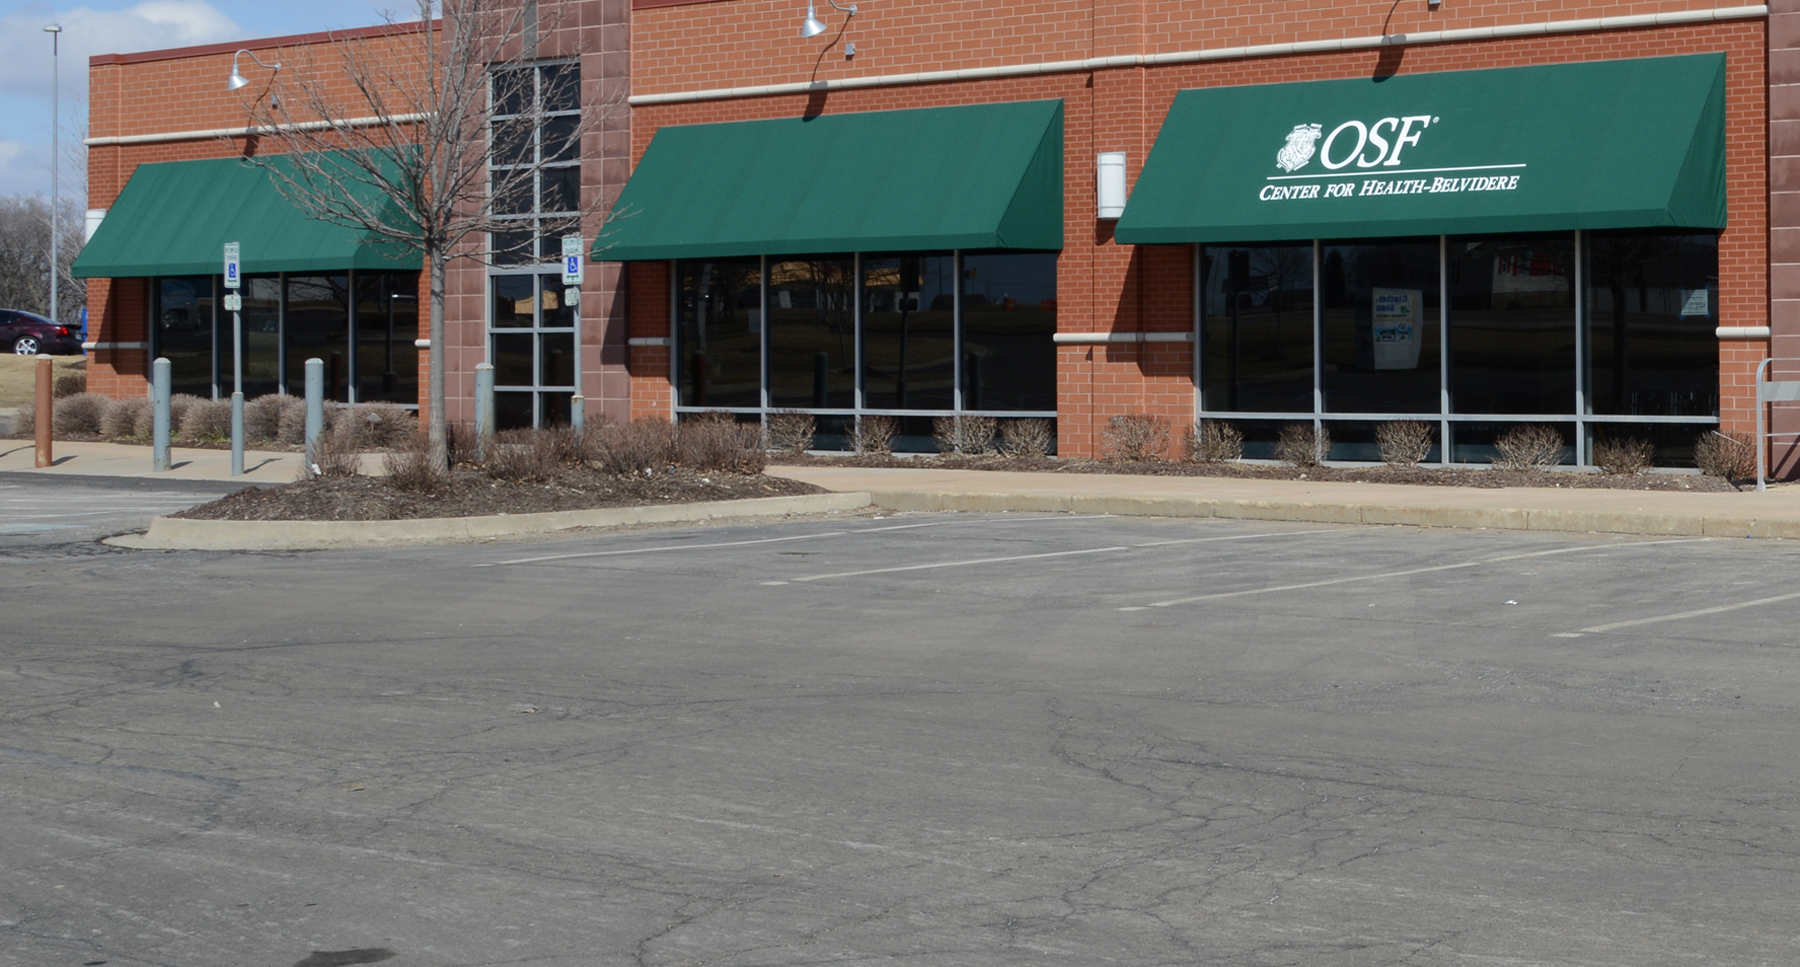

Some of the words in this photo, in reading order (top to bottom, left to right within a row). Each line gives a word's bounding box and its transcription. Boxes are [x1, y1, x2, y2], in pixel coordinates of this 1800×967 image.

[1320, 114, 1432, 170] OSF
[1259, 184, 1321, 201] CENTER
[1323, 182, 1356, 198] FOR
[1358, 175, 1520, 196] HEALTH-BELVIDERE
